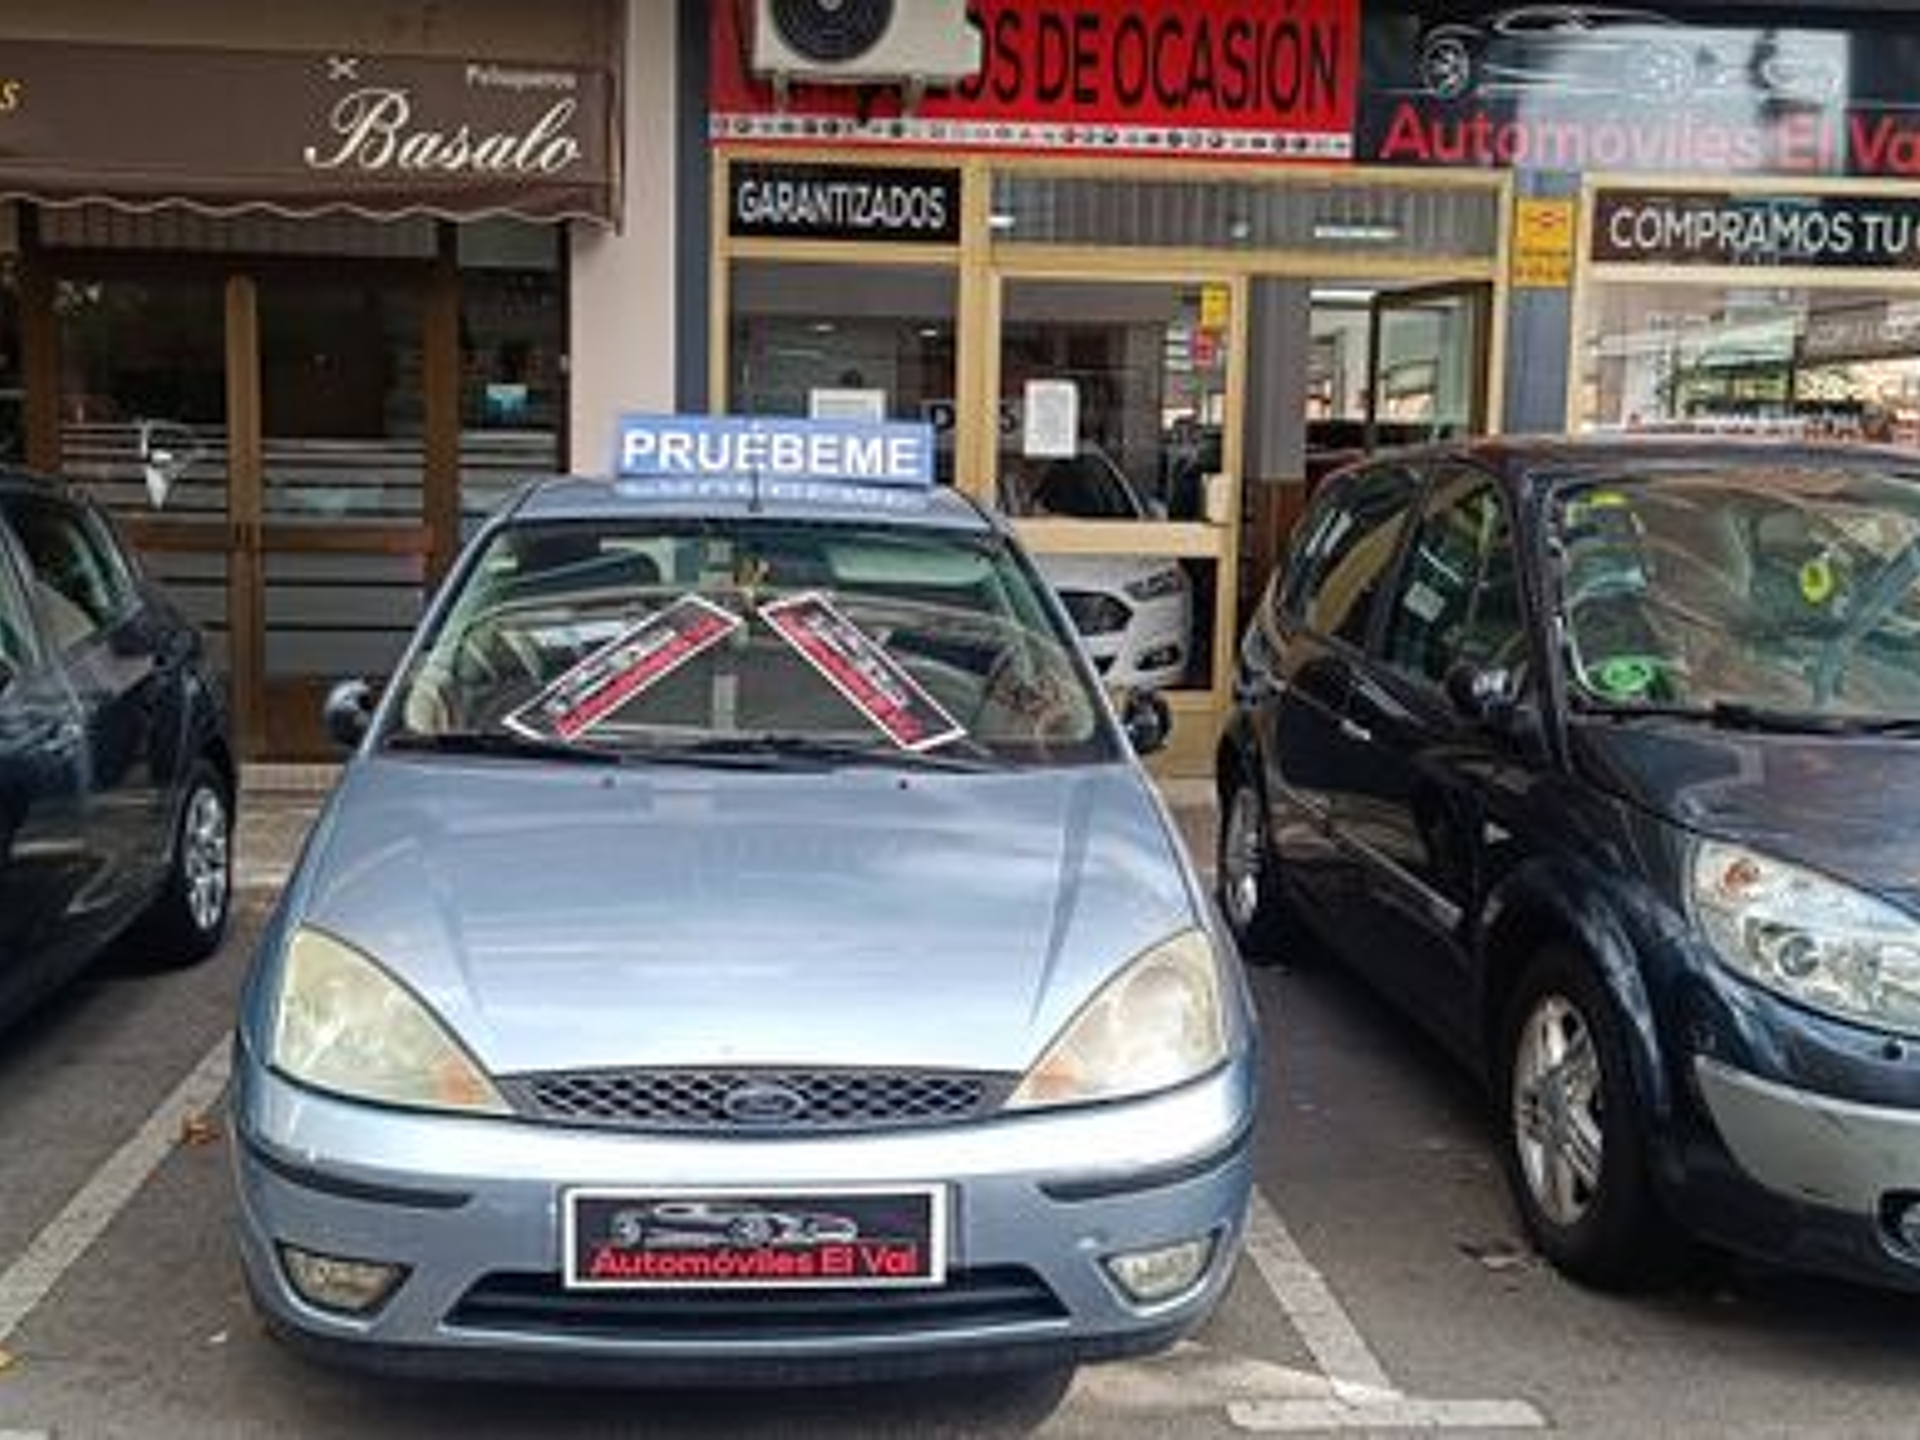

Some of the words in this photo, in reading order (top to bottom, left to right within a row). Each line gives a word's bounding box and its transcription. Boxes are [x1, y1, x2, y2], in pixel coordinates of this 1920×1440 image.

[1036, 15, 1099, 104] DE
[1113, 0, 1340, 114] OCASIÓN
[304, 87, 581, 173] Basalo
[1778, 111, 1837, 171] El
[738, 179, 947, 230] GARANTIZADOS
[1610, 208, 1852, 255] COMPRAMOS
[1861, 213, 1909, 254] TU
[622, 421, 922, 477] PRUÉBEME
[821, 1246, 855, 1275] El
[861, 1243, 918, 1275] Val
